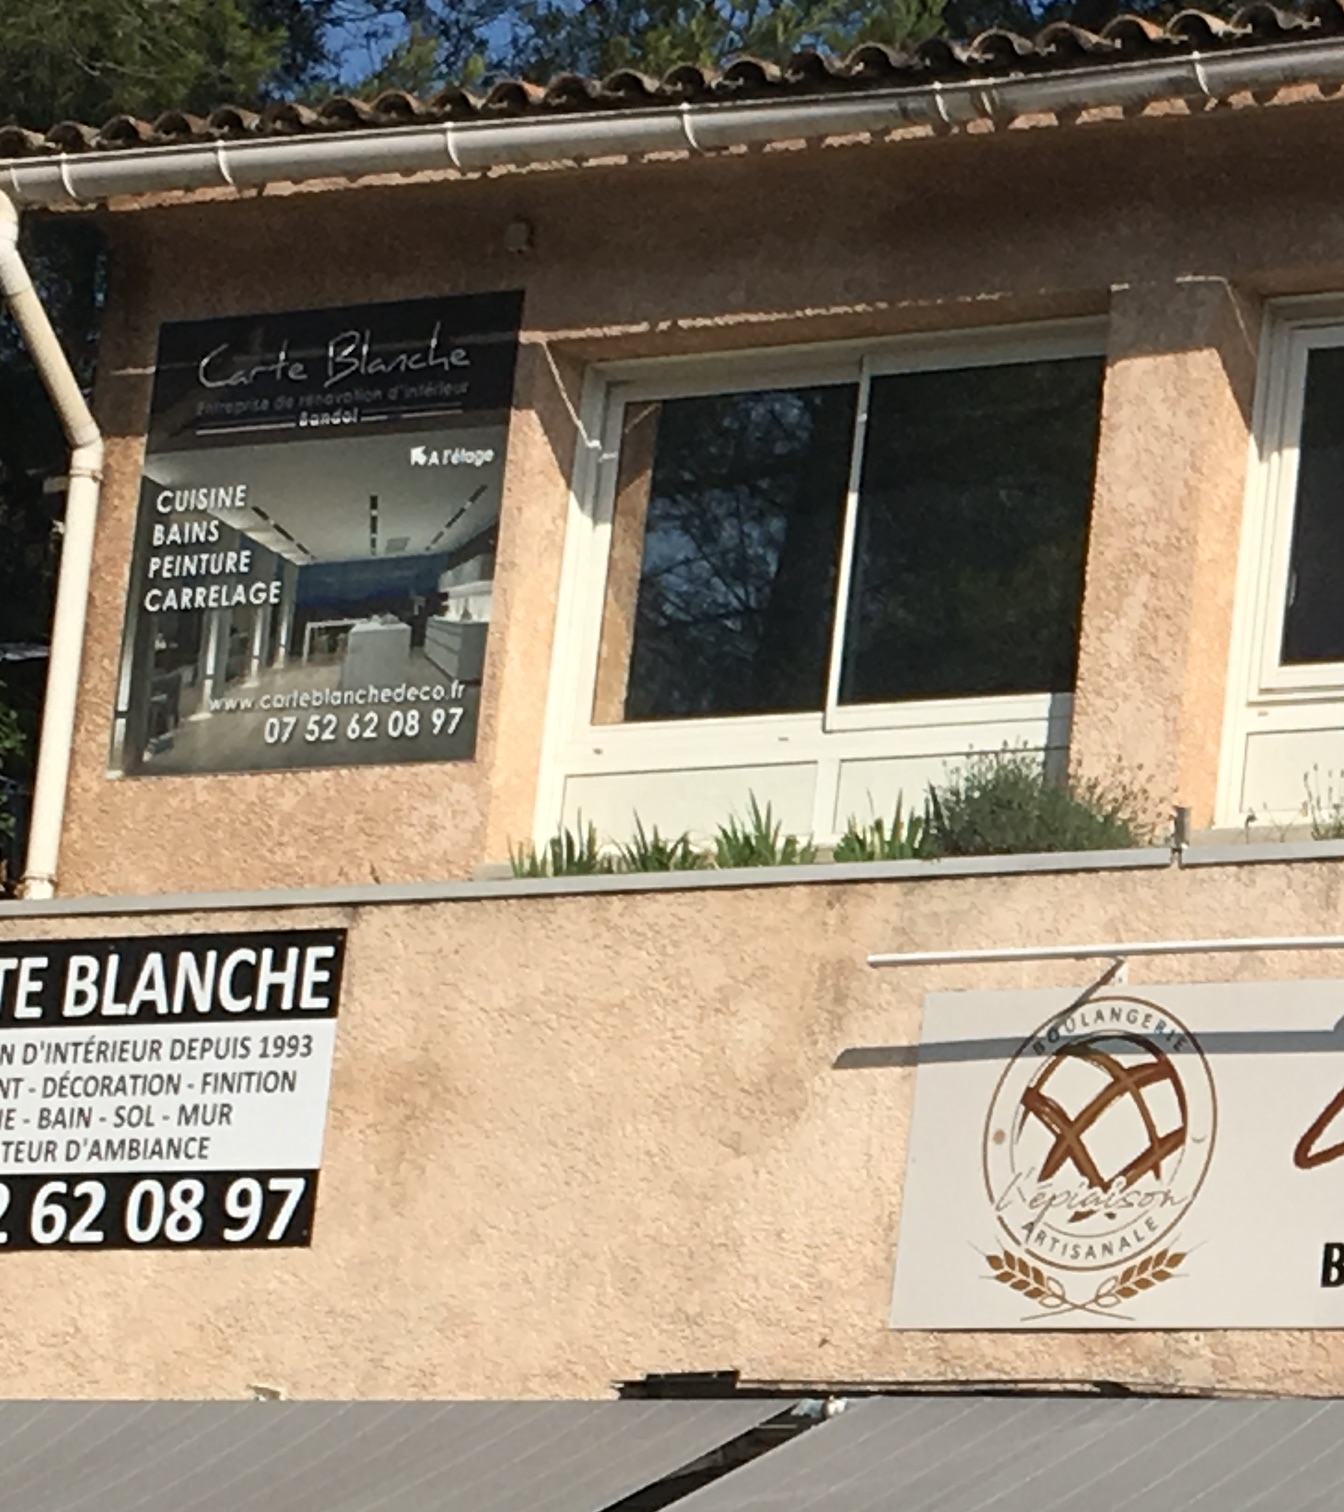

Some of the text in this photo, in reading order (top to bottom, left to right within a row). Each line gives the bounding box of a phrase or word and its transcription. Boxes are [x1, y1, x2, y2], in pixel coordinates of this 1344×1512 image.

[199, 321, 471, 388] Carte Blanche
[156, 485, 248, 514] CUISINE
[152, 520, 220, 547] BAINS
[148, 550, 252, 579] PEINTURE
[144, 581, 283, 613] CARRELAGE
[263, 706, 465, 744] 07 52 62 08 97
[62, 945, 336, 1018] BLANCHE
[1032, 1006, 1191, 1057] BOULANGERIE
[22, 1034, 163, 1066] D'INTÉRIEUR
[168, 1036, 252, 1062] DEPUIS
[258, 1033, 314, 1059] 1993
[42, 1069, 182, 1099] DÉCORATION
[200, 1069, 298, 1095] FINITION
[37, 1106, 93, 1131] BAIN
[113, 1104, 156, 1129] SOL
[176, 1102, 234, 1127] MUR
[2, 1136, 212, 1164] TEUR D'AMBIANCE
[31, 1180, 106, 1244] 62
[125, 1178, 205, 1243] 08
[223, 1176, 306, 1241] 97
[1021, 1216, 1160, 1261] ARTISANALE
